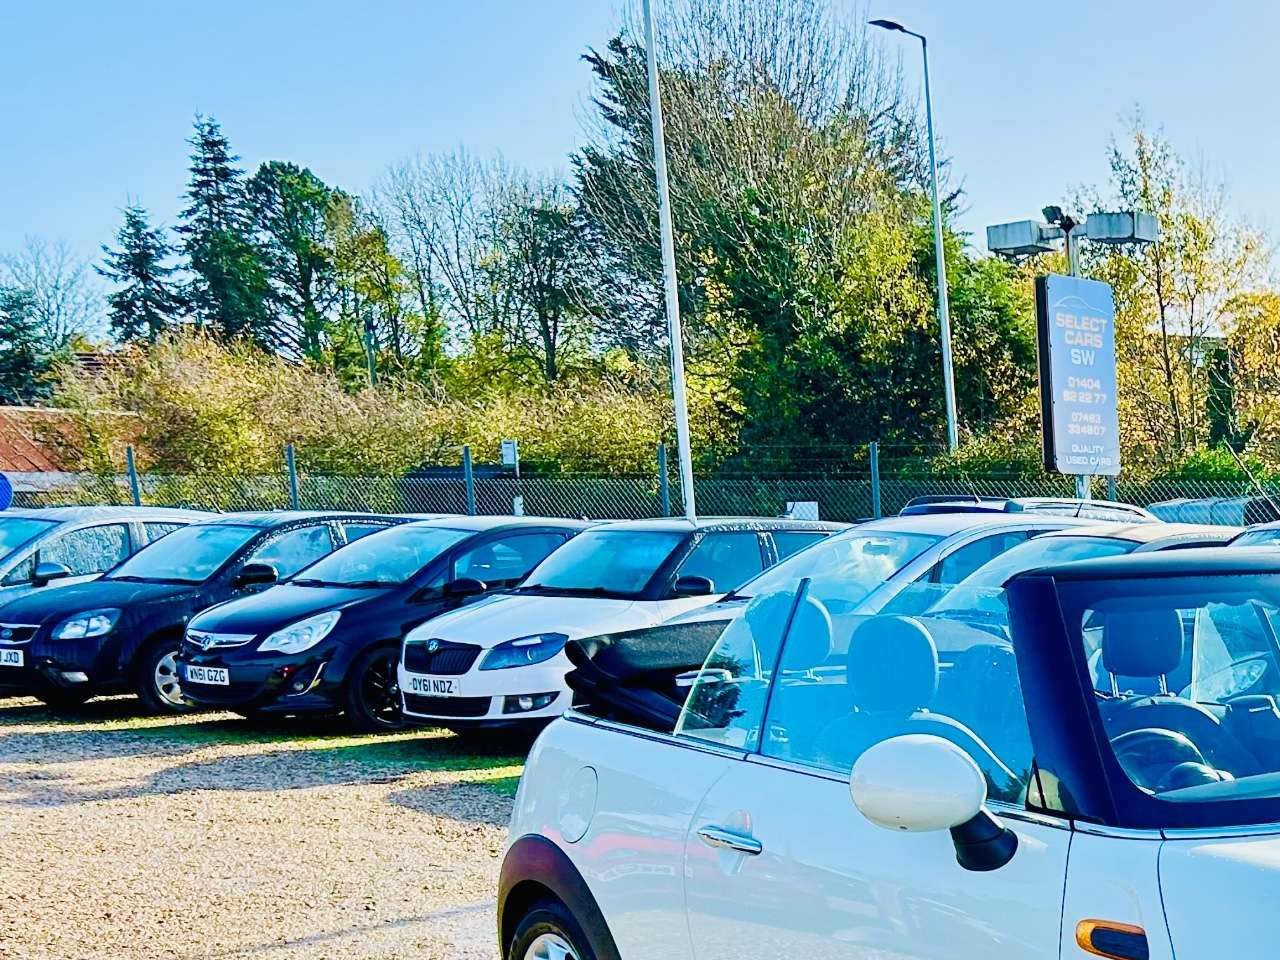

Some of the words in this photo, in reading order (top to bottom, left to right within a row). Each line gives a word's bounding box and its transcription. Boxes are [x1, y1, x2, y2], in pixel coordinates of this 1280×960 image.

[1055, 312, 1107, 333] SELECT
[1064, 330, 1103, 349] CARS
[1071, 348, 1095, 366] SW
[1067, 376, 1101, 390] 01404
[1071, 443, 1105, 455] QUALITY
[1065, 455, 1088, 465] USED
[432, 679, 453, 694] NDZ
